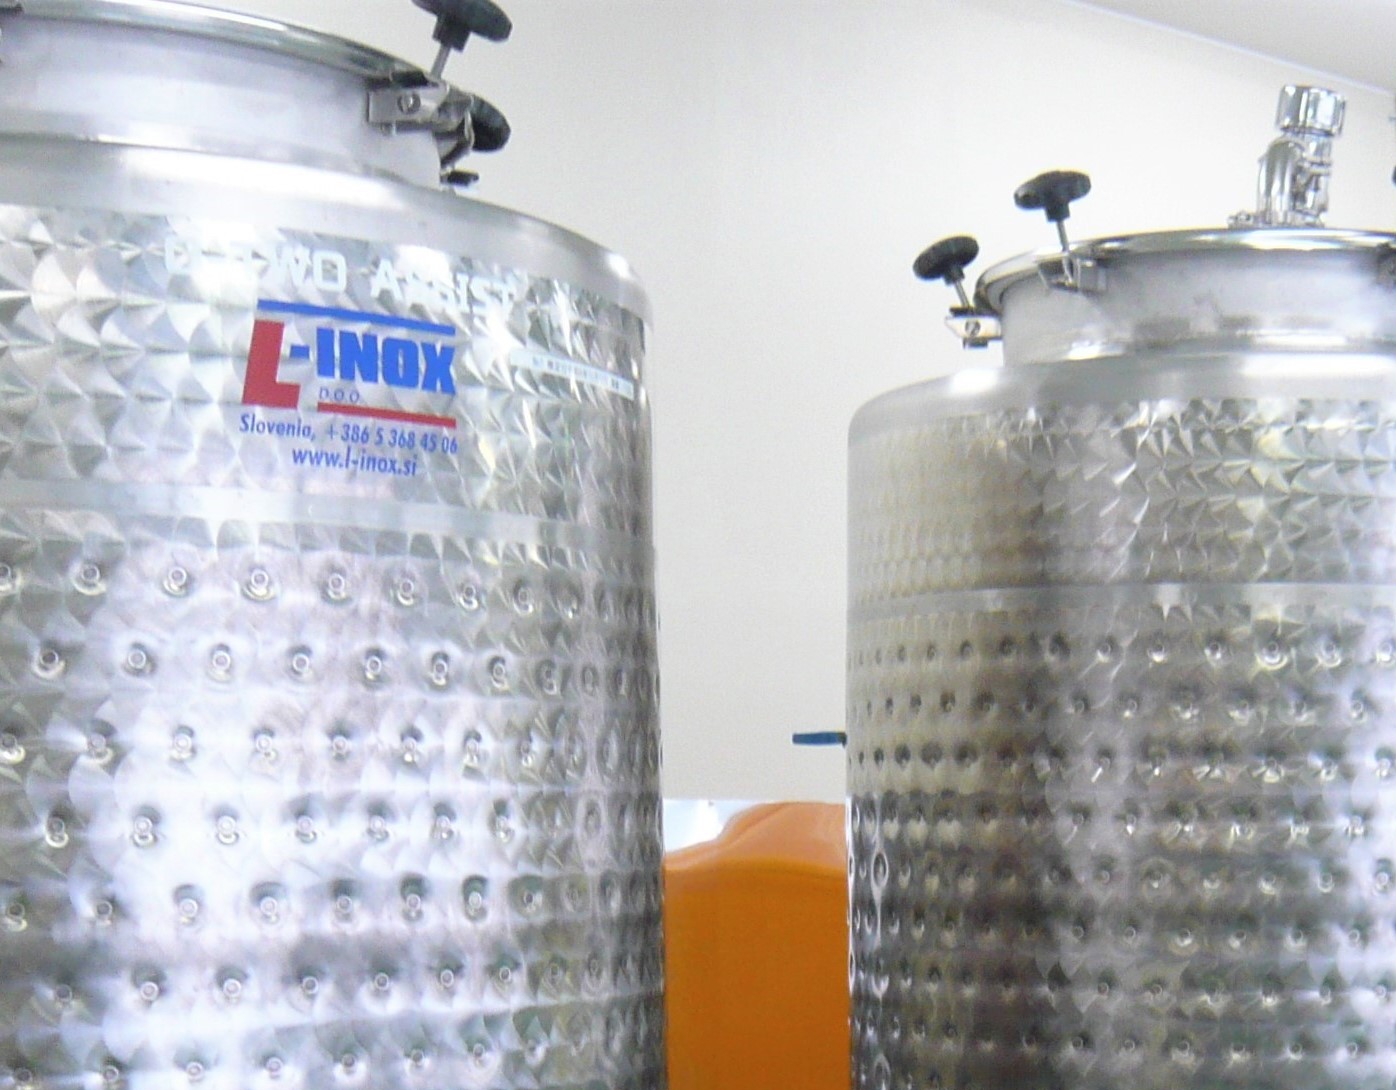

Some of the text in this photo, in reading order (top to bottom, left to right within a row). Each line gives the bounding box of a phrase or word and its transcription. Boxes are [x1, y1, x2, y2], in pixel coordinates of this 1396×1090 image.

[241, 319, 457, 409] L-INOX
[239, 413, 316, 441] Slovenia,
[375, 427, 384, 446] 5
[388, 428, 416, 450] 368
[421, 432, 437, 453] 45
[441, 436, 458, 454] 06
[292, 445, 418, 477] www.l-inox.si
